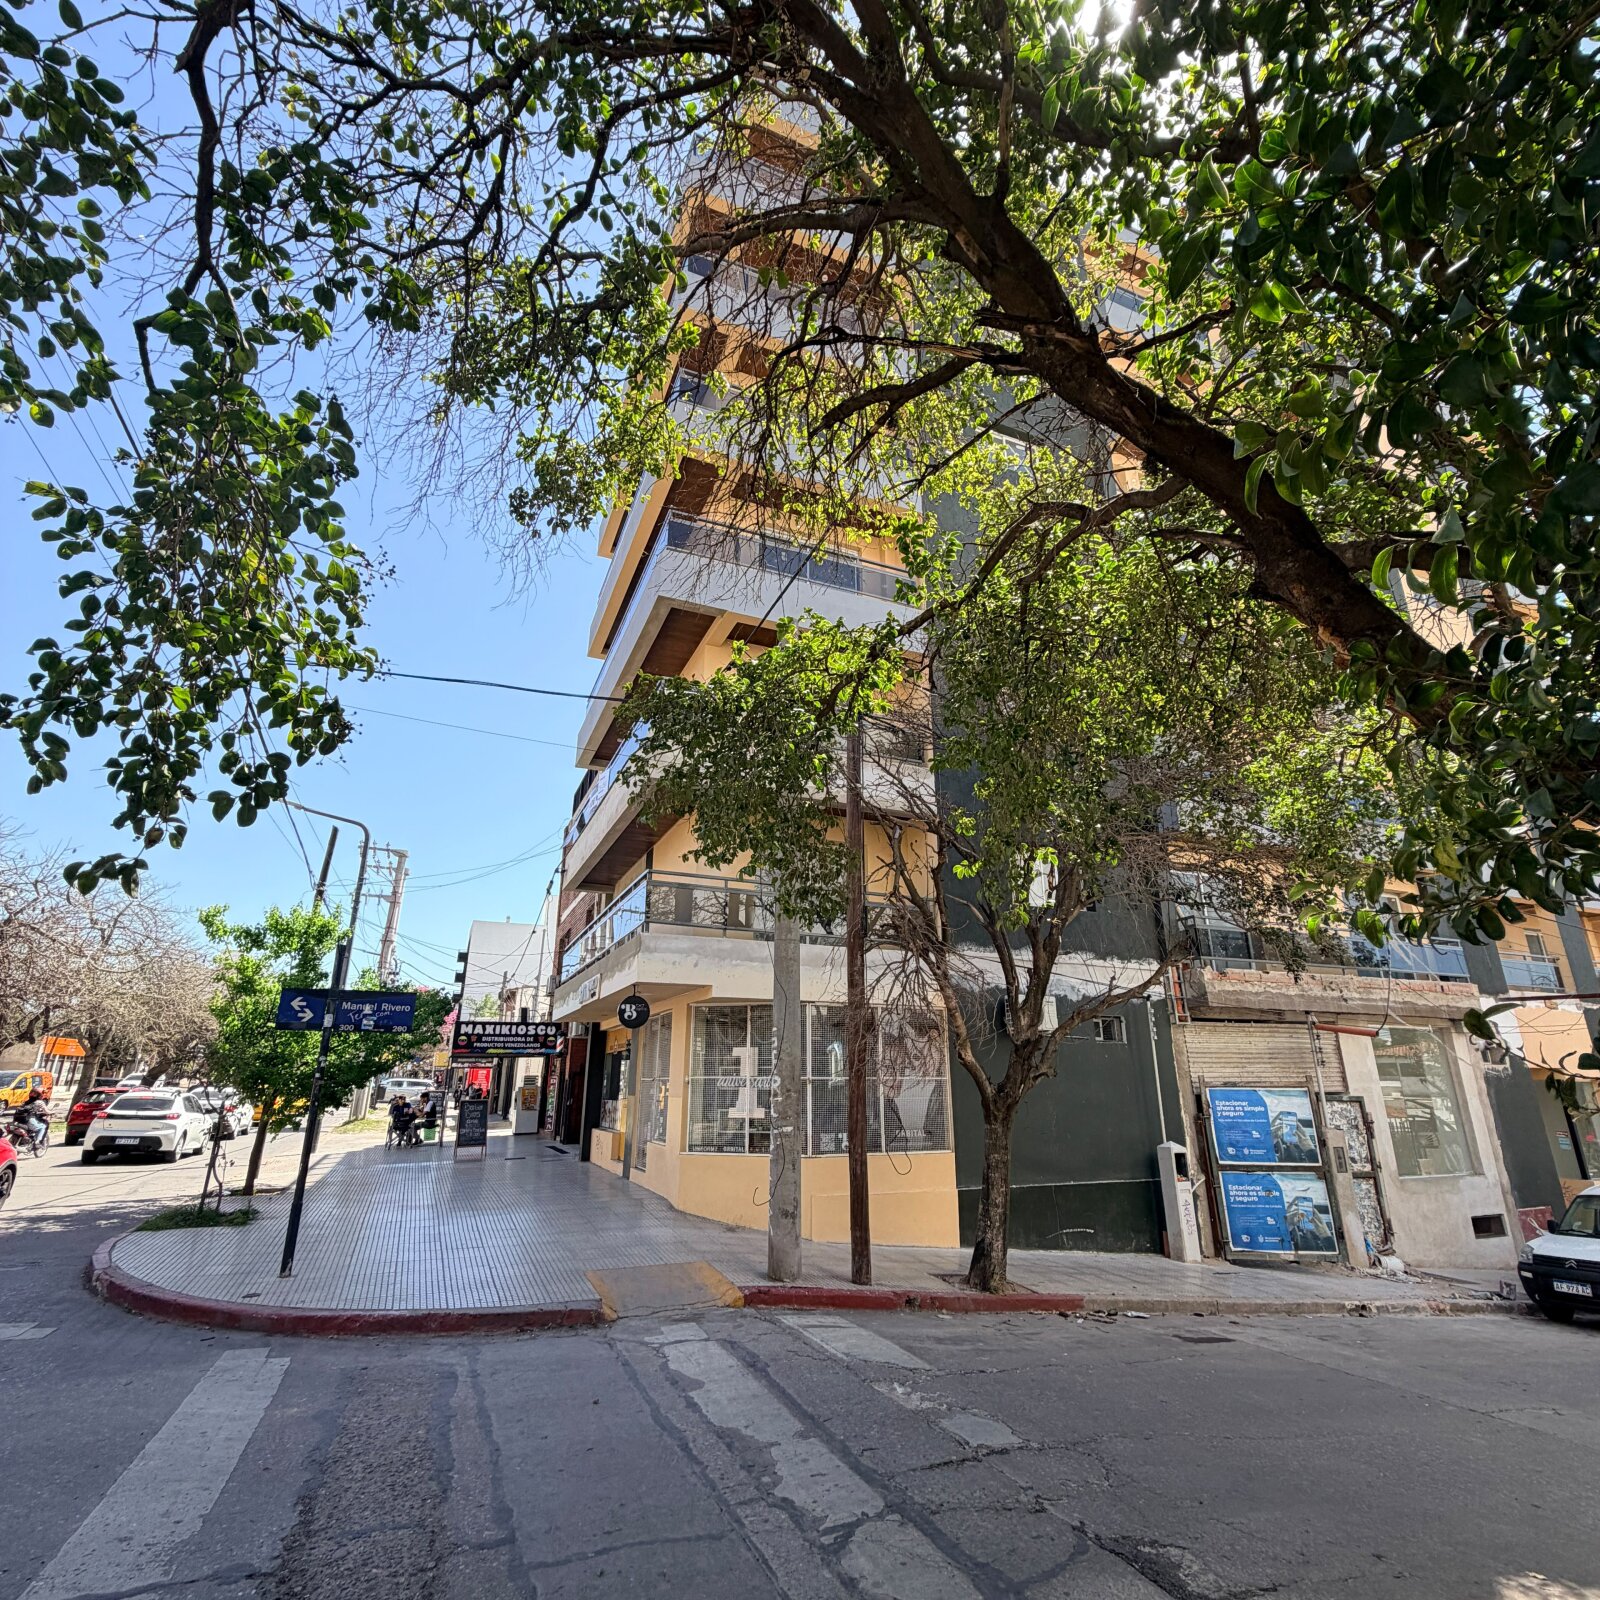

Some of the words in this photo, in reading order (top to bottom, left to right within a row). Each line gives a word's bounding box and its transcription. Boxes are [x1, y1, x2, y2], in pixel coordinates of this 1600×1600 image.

[341, 1001, 378, 1011] Manuel
[381, 1002, 411, 1012] Rivero
[460, 1023, 557, 1035] MAXIKIOSCO
[895, 1129, 927, 1137] ORBITAL
